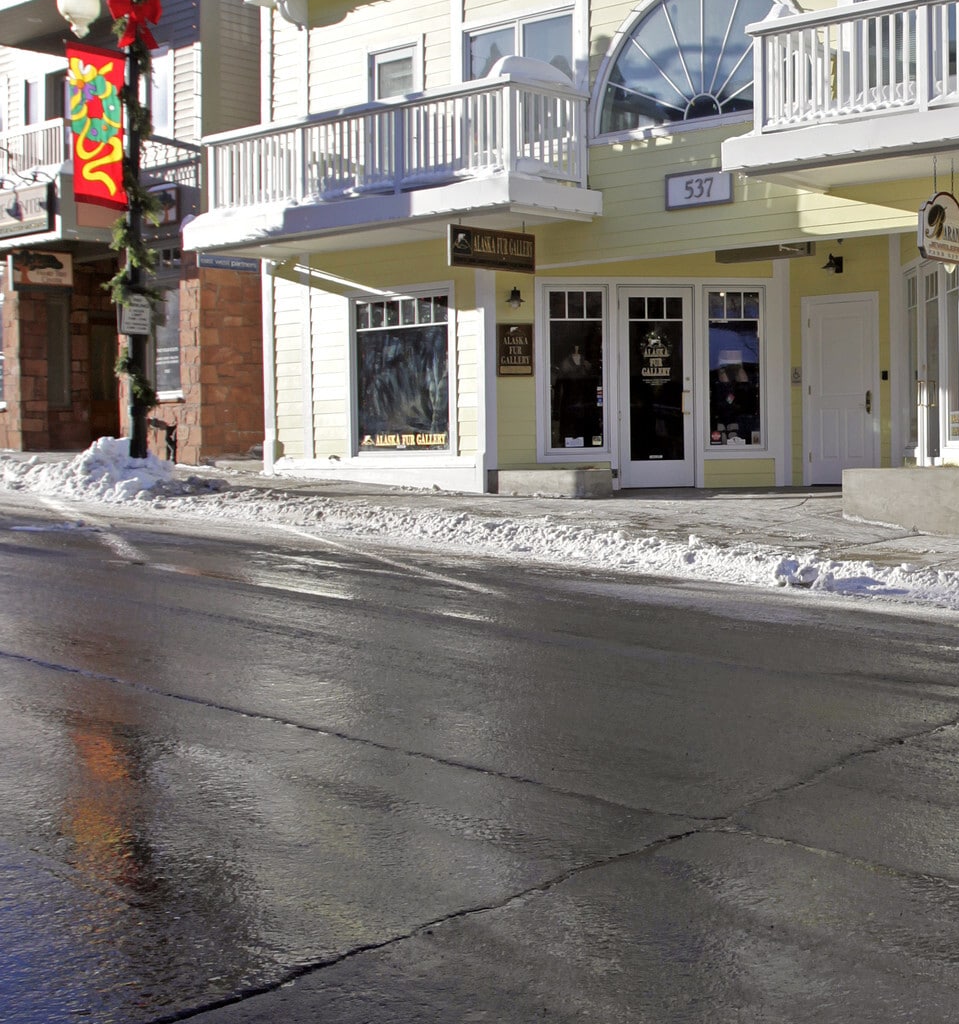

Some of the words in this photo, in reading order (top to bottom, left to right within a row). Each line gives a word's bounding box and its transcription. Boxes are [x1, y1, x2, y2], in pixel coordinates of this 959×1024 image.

[684, 177, 714, 200] 537
[473, 234, 496, 254] ALASKA
[496, 237, 509, 255] FUR
[508, 238, 534, 257] GALLERY
[503, 336, 529, 345] ALASKA
[509, 346, 522, 355] FUR
[643, 346, 671, 358] ALASKA
[500, 355, 530, 365] GALLERY
[649, 357, 663, 367] FUR
[641, 367, 671, 377] GALLERY
[375, 433, 400, 447] ALASKA
[401, 434, 415, 446] FUR
[416, 433, 446, 446] GALLERY
